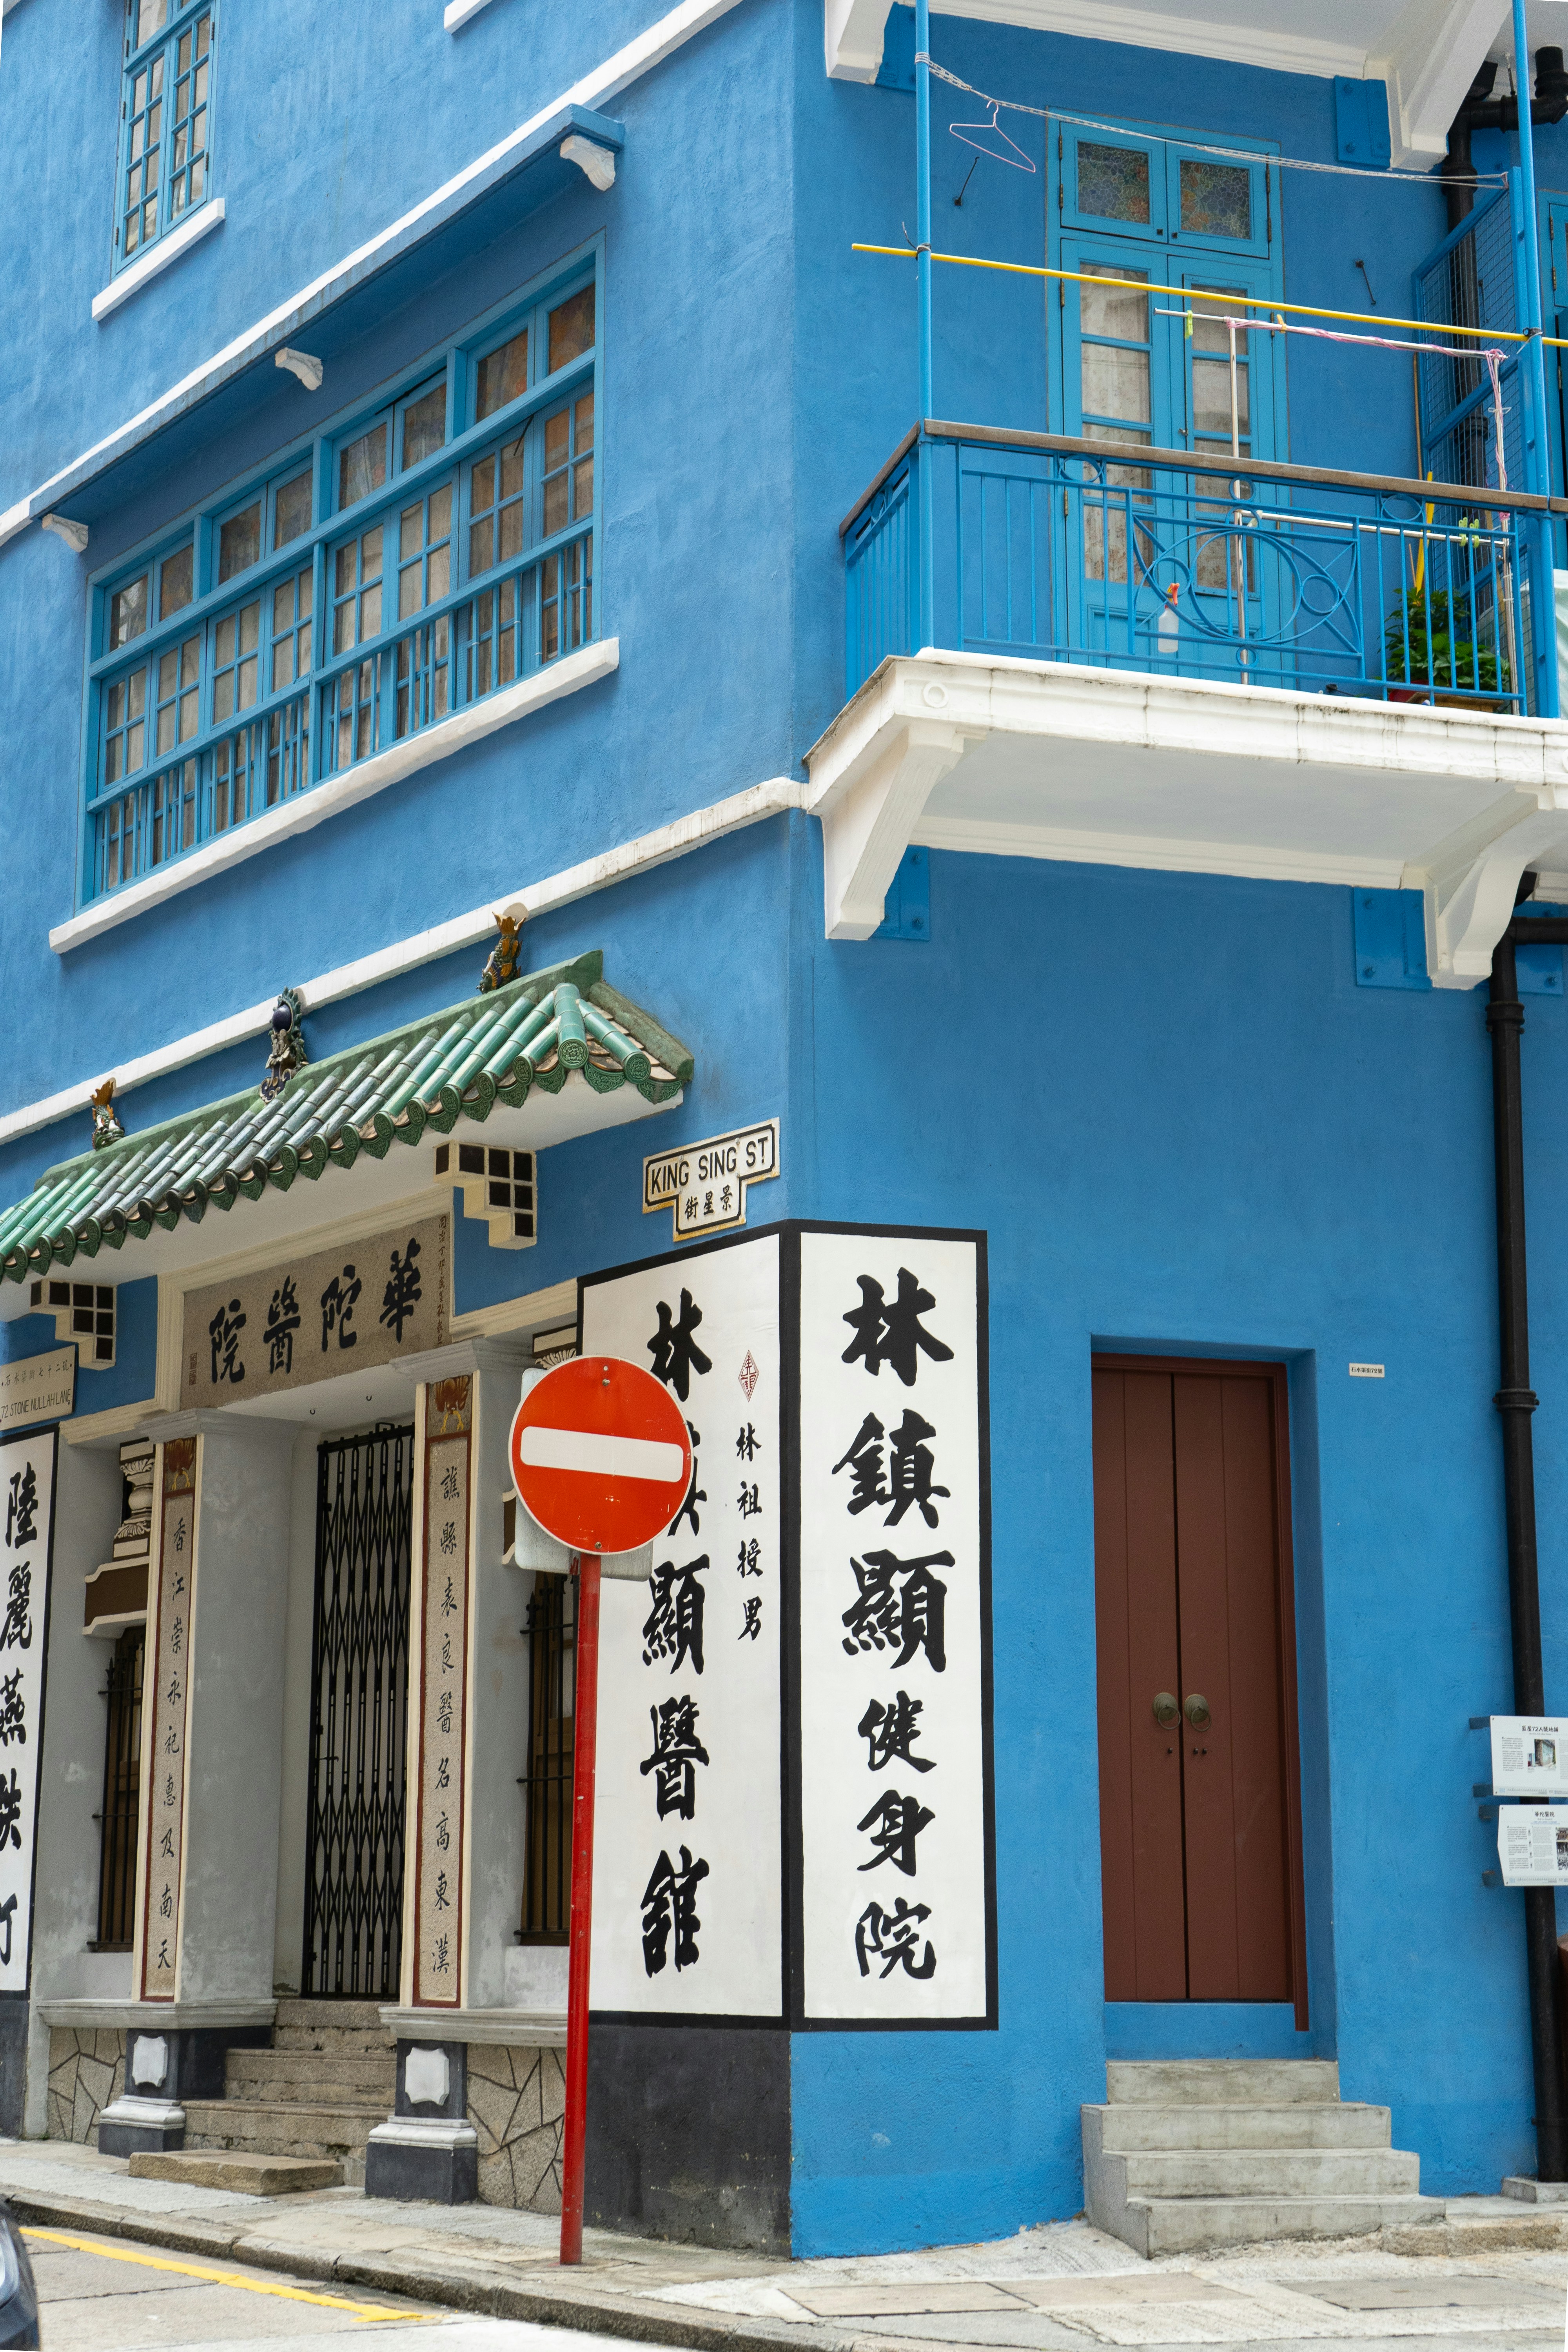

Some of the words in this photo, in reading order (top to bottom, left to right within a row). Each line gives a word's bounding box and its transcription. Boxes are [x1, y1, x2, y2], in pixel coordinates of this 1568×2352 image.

[652, 1160, 689, 1194] KING
[698, 1146, 737, 1180] SING
[1, 1405, 8, 1419] 72
[10, 1399, 29, 1417] STONE
[30, 1392, 55, 1411] NULLAH
[56, 1388, 71, 1405] LANE
[736, 1422, 764, 1641] 林祖授男
[831, 1267, 956, 1979] 林鎮顯健身院
